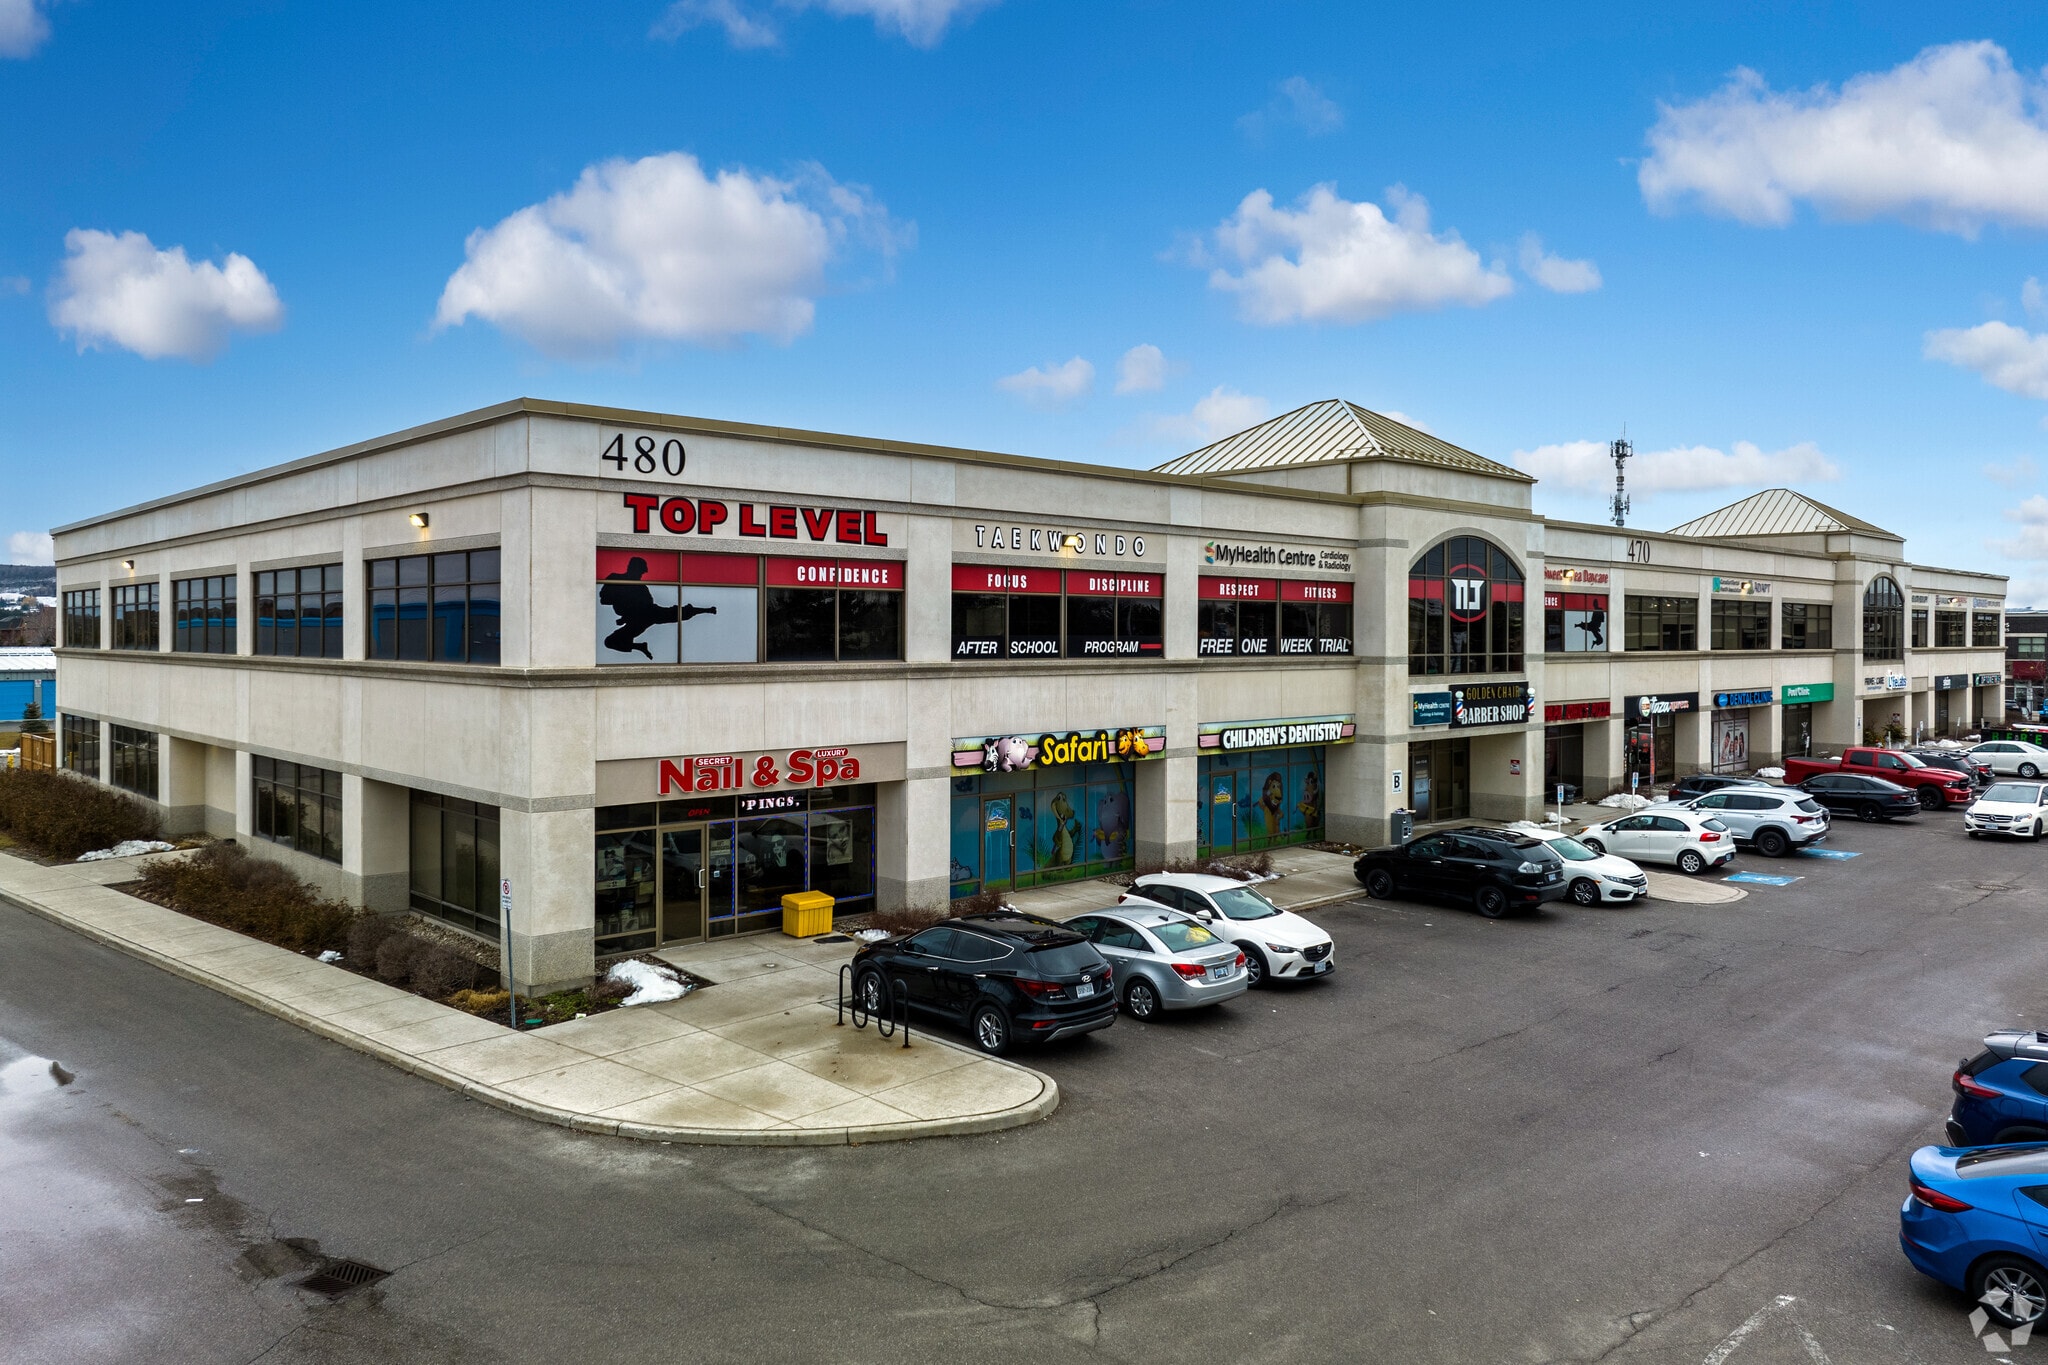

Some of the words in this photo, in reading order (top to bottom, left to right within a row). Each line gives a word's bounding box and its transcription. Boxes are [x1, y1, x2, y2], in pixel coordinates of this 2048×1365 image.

[602, 433, 686, 476] 480
[624, 492, 728, 535] TOP
[739, 503, 888, 547] LEVEL
[975, 525, 1146, 557] TAEKWONDO
[1216, 544, 1276, 566] MyHealth
[1279, 548, 1316, 567] Centre
[1320, 550, 1349, 561] Cardiology
[1627, 540, 1651, 563] 470
[1318, 560, 1323, 569] &
[1324, 560, 1351, 572] Radiology
[797, 566, 888, 584] CONFIDENCE
[987, 573, 1028, 589] FOCUS
[1583, 569, 1609, 585] Daycare
[1089, 577, 1150, 593] DISCIPLINE
[1220, 583, 1259, 596] RESPECT
[1304, 586, 1337, 599] FITNESS
[957, 640, 998, 655] AFTER
[1010, 640, 1059, 654] SCHOOL
[1084, 641, 1139, 654] PROGRAM
[1199, 638, 1233, 654] FREE
[1241, 638, 1268, 653] ONE
[1280, 638, 1313, 653] WEEK
[1320, 638, 1350, 653] TRIAL
[1466, 686, 1496, 700] GOLDEN
[1497, 685, 1521, 699] CHAIR
[1461, 705, 1500, 725] BARBER
[1500, 704, 1526, 722] SHOP
[1223, 727, 1287, 750] CHILDREN'S
[1288, 721, 1343, 744] DENTISTRY
[817, 748, 846, 757] LUXURY
[1040, 733, 1108, 766] Safari
[698, 756, 731, 766] SECRET
[658, 757, 743, 796] Nail
[750, 755, 780, 788] &
[785, 749, 860, 788] Spa
[1394, 775, 1400, 788] B
[741, 796, 800, 811] PINGS,
[687, 808, 710, 817] OPEN
